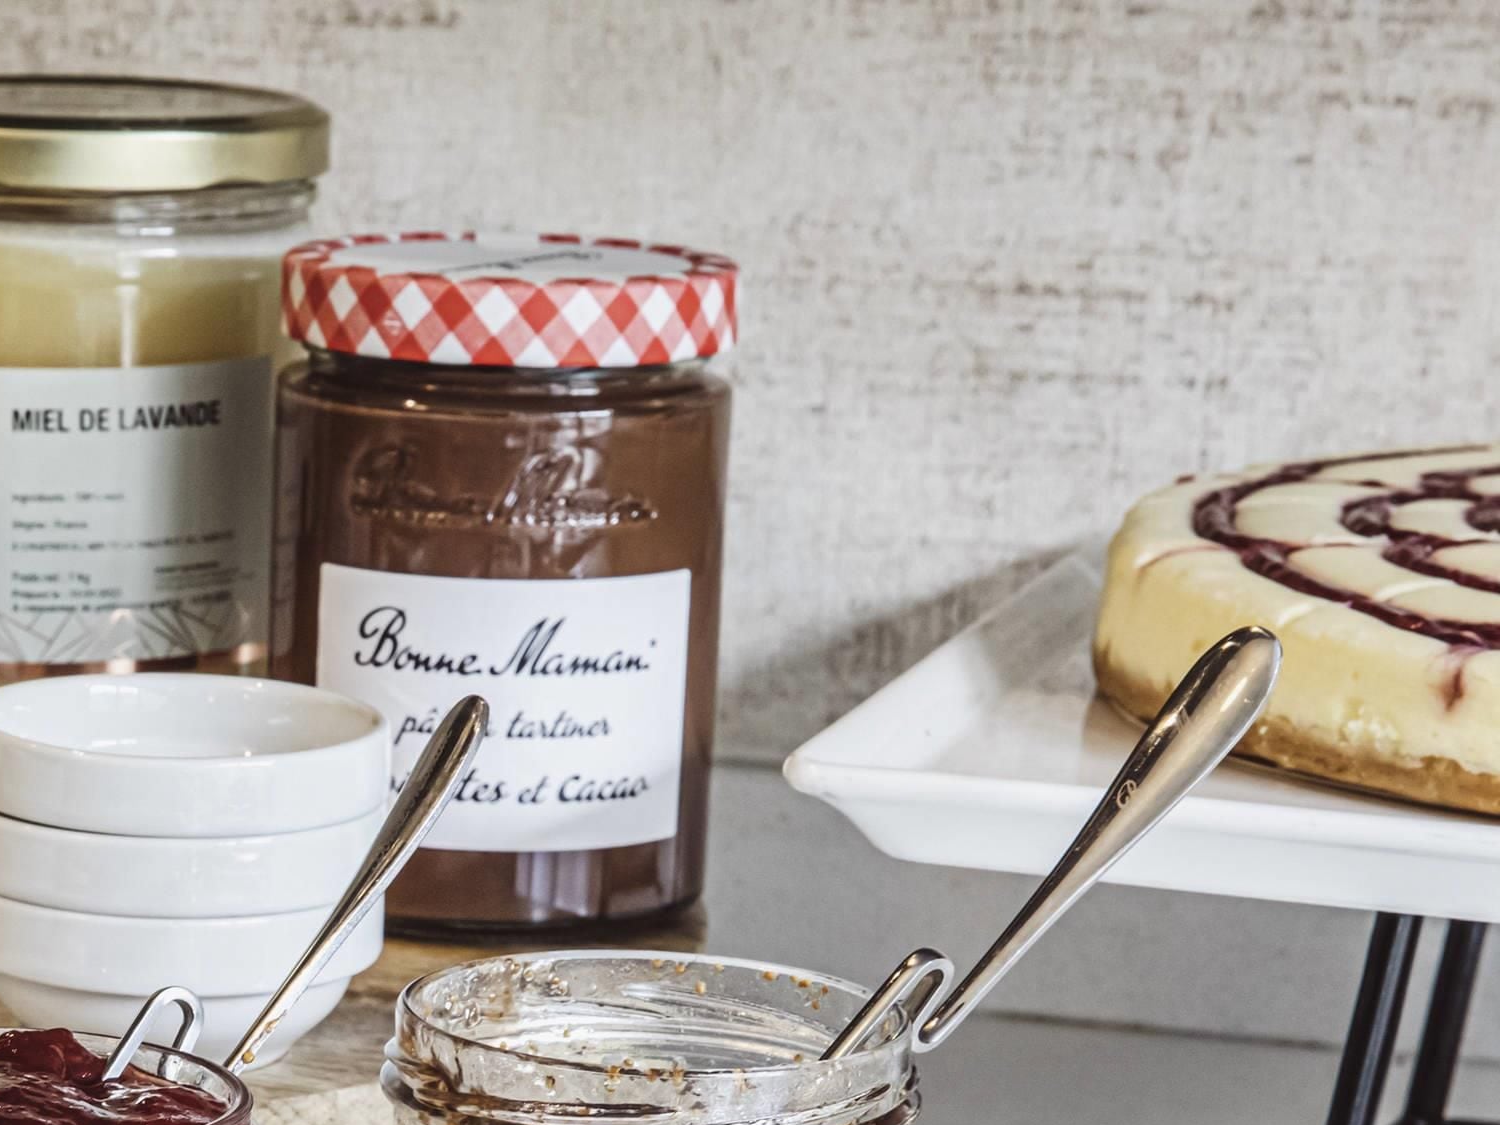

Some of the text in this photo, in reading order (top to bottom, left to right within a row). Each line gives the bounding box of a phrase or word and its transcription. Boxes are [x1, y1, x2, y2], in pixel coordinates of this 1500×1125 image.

[11, 400, 222, 433] MIEL DE LAVANDE
[354, 606, 482, 675] Bonne
[506, 711, 610, 739] tartiner
[517, 775, 548, 803] et
